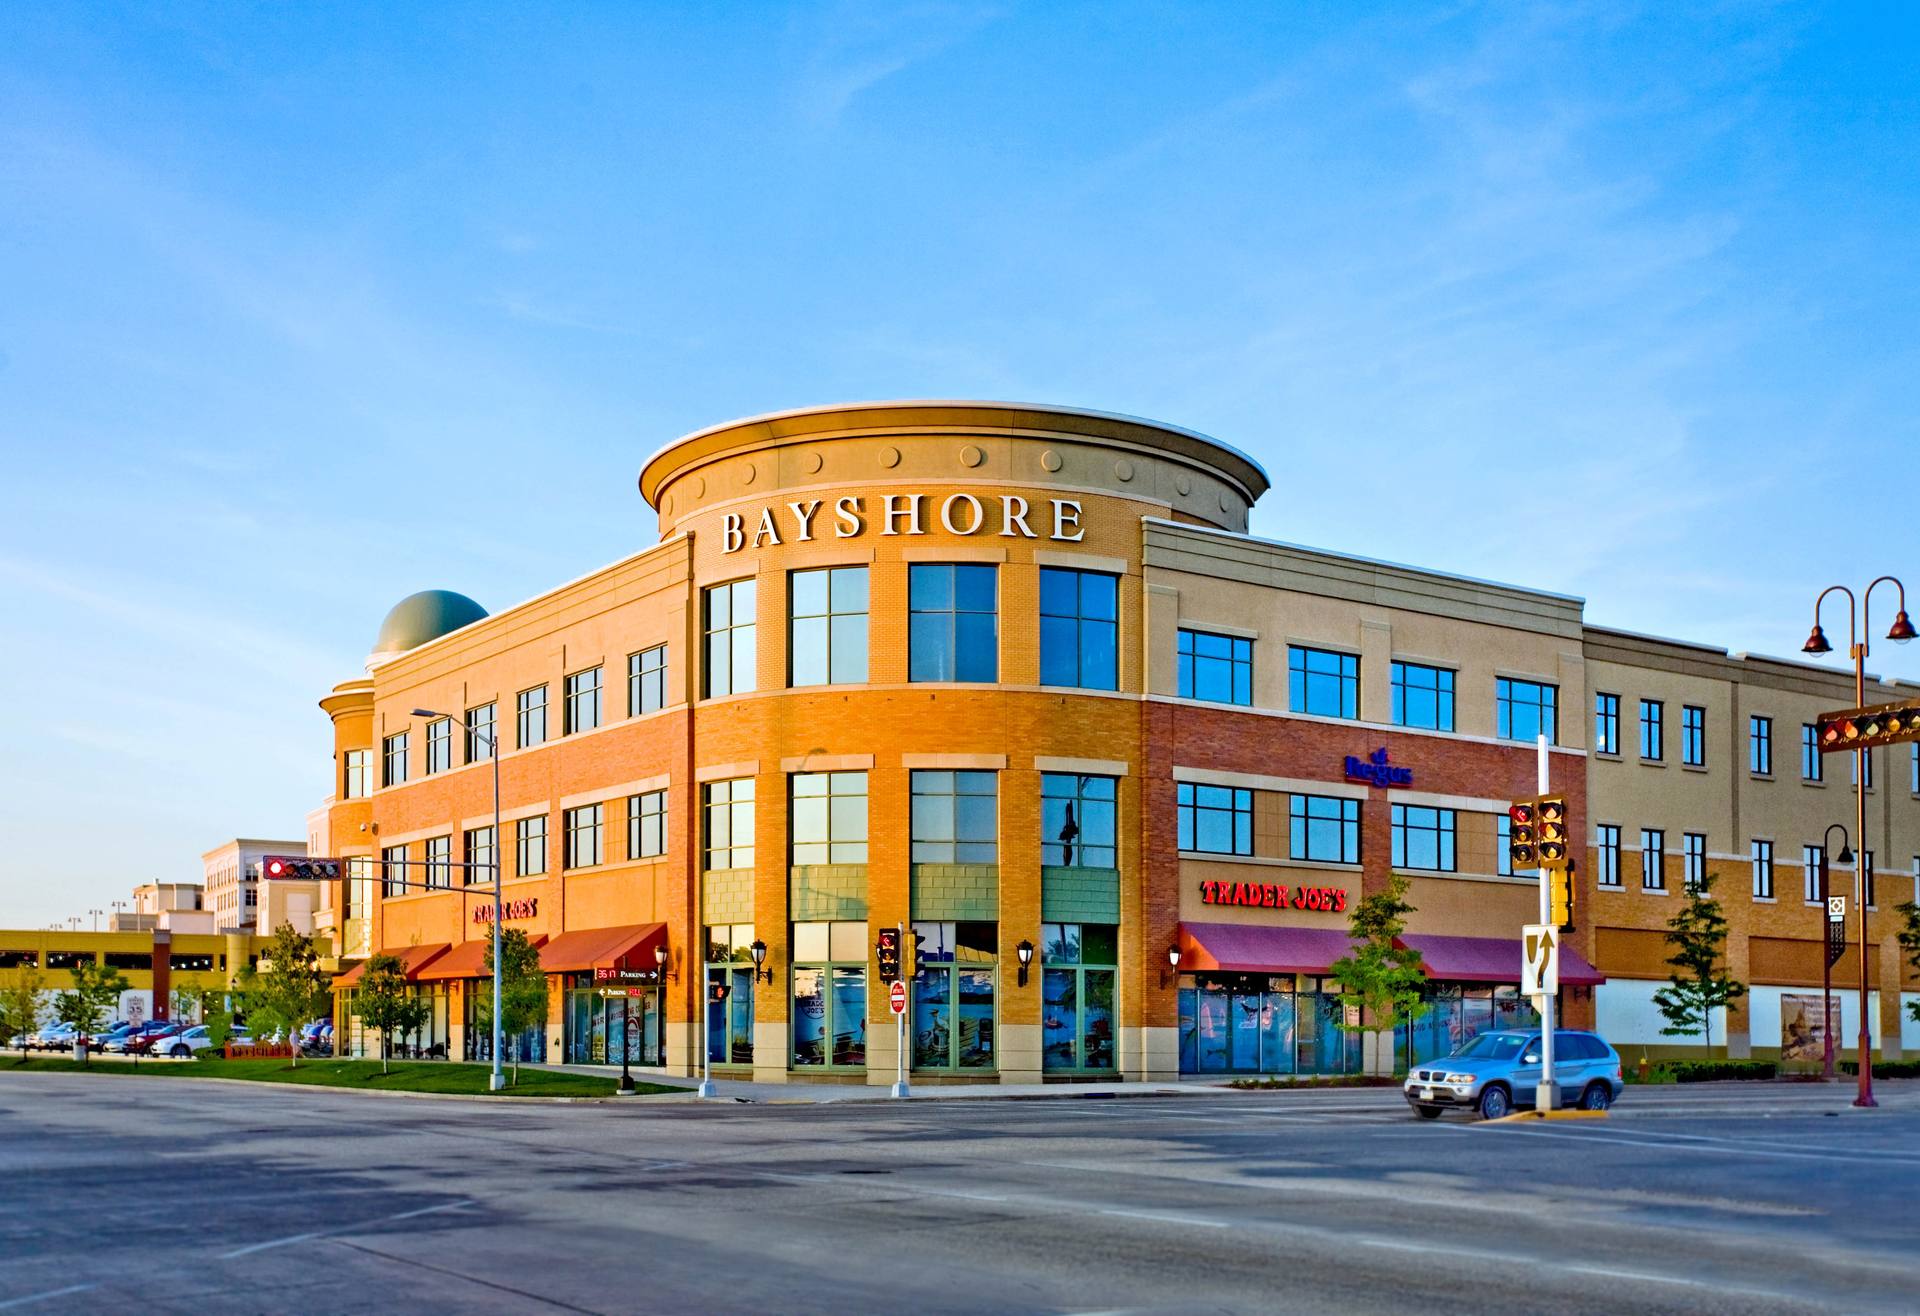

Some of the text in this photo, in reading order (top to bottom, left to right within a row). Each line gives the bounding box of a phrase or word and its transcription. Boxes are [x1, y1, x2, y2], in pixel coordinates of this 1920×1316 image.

[720, 493, 1086, 555] BAYSHORE
[1344, 756, 1412, 788] Regus
[1200, 880, 1347, 912] TRADER JOE'S
